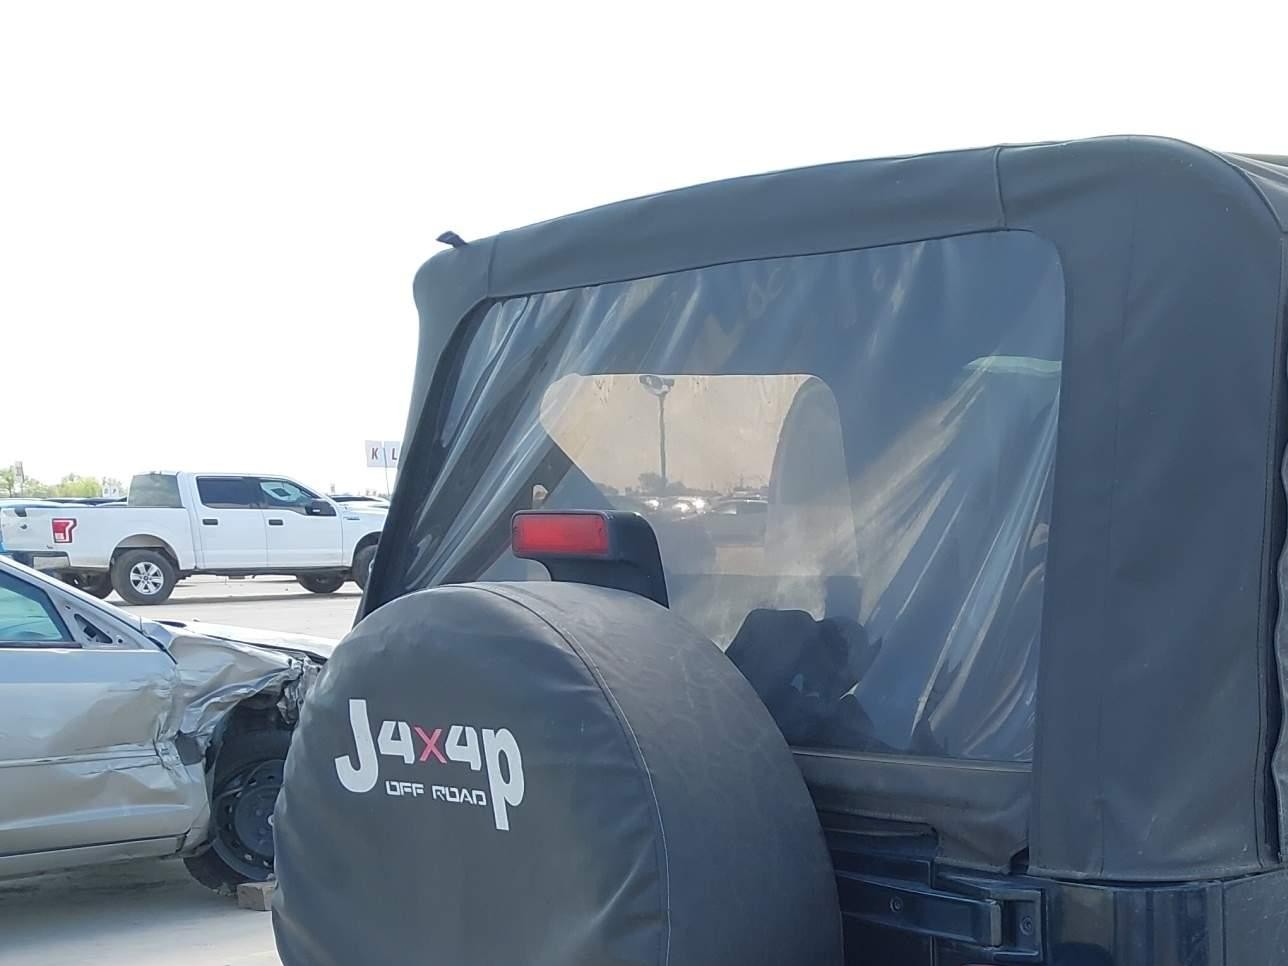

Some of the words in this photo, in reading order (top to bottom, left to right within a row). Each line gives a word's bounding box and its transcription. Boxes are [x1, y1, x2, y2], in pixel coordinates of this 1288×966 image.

[371, 447, 379, 460] K
[385, 780, 425, 798] OFF
[431, 785, 487, 806] ROAD
